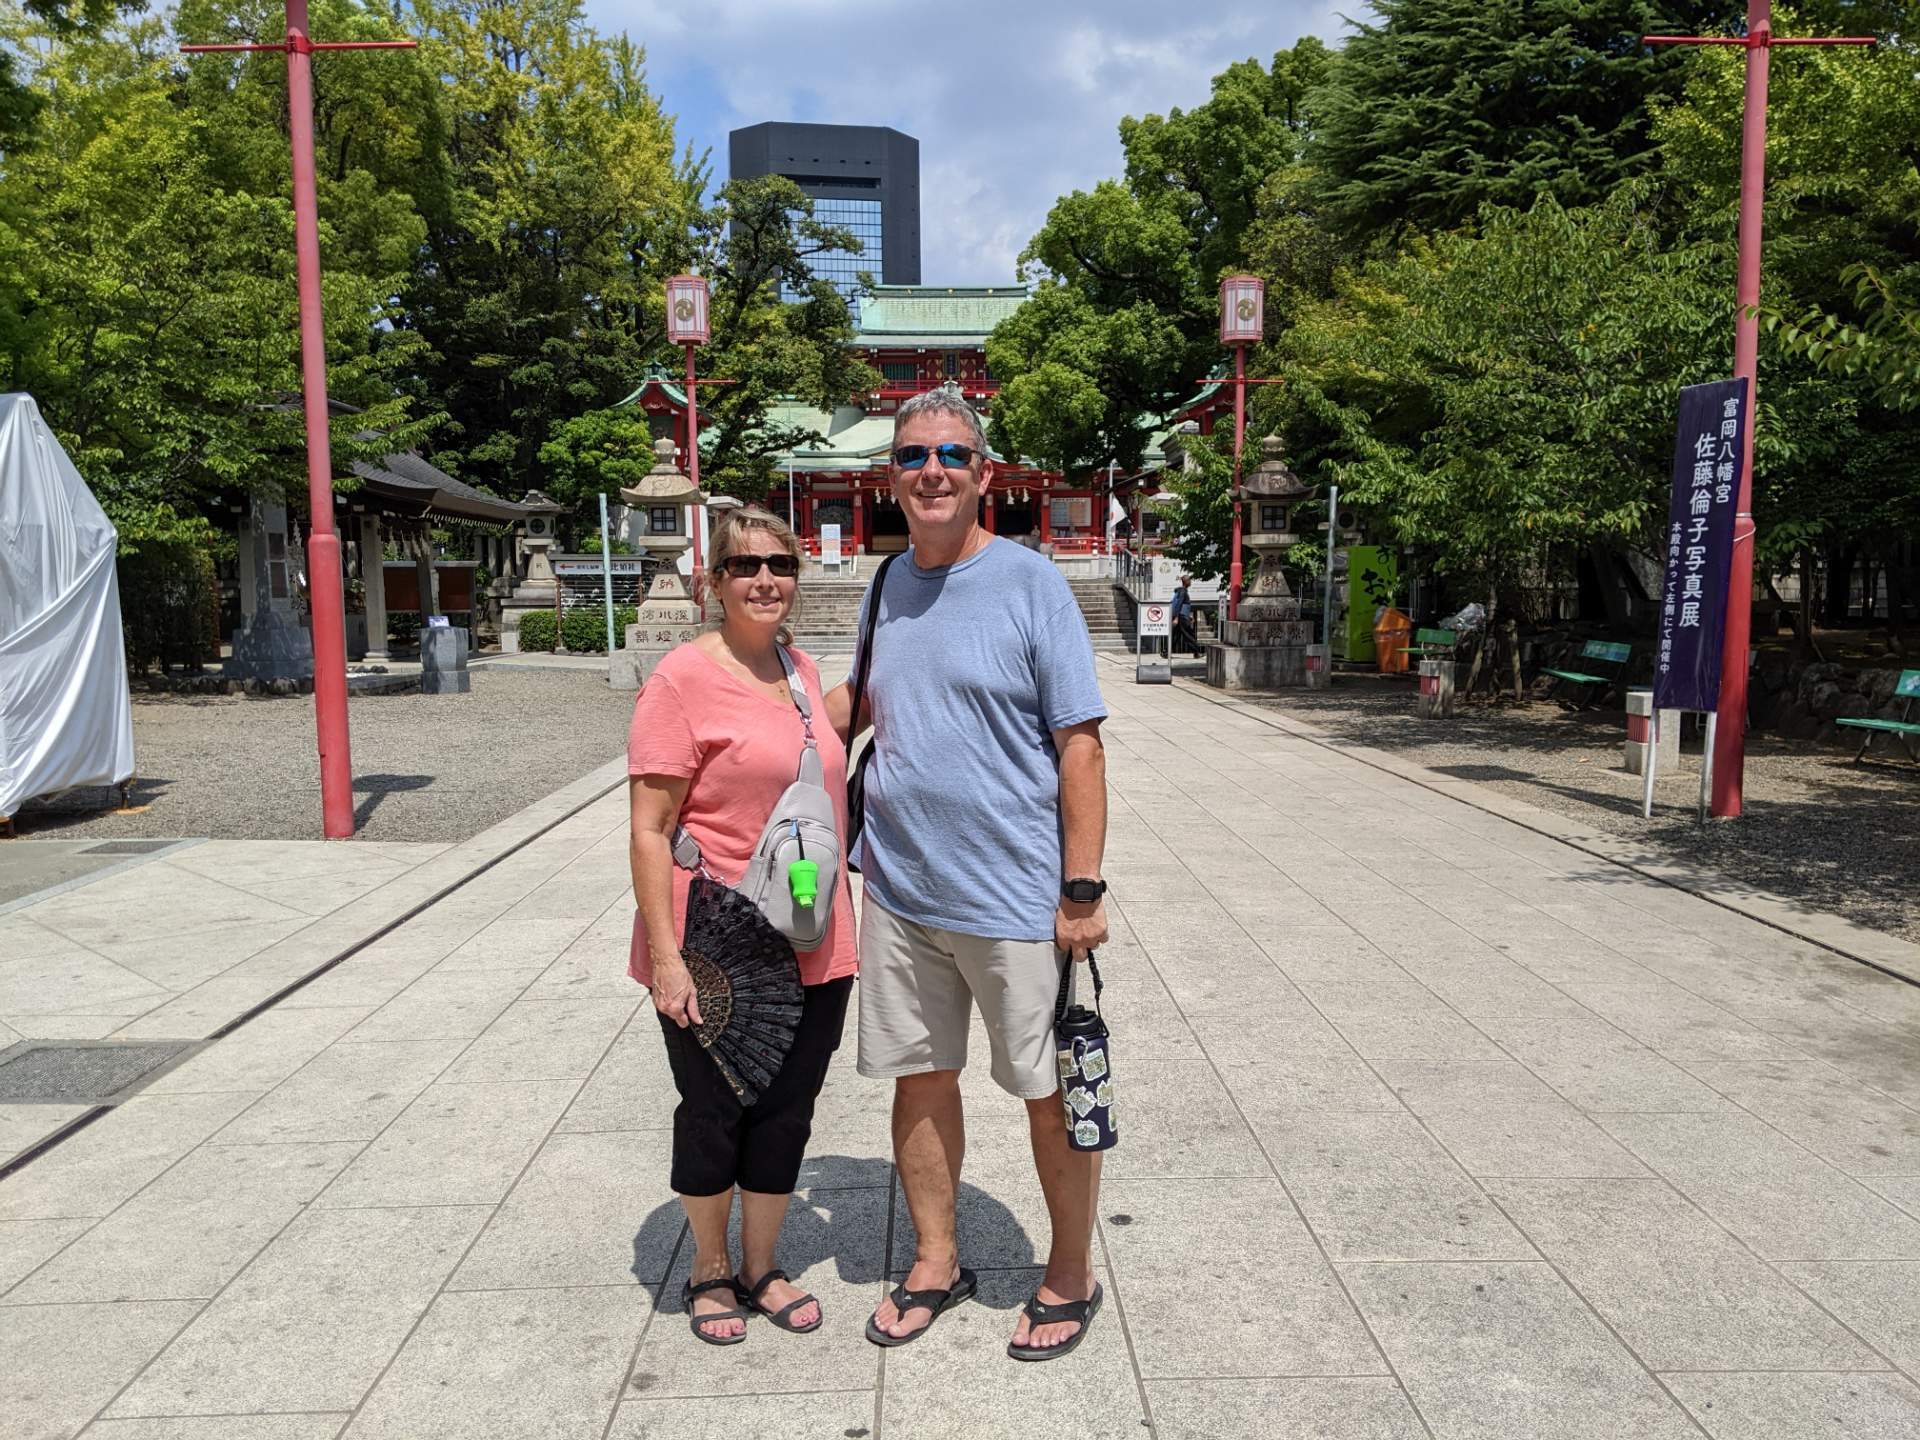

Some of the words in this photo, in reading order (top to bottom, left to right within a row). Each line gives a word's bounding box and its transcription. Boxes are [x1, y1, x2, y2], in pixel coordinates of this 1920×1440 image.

[1715, 397, 1739, 504] 富岡八幡宮
[1678, 432, 1718, 628] 佐藤倫子写真展
